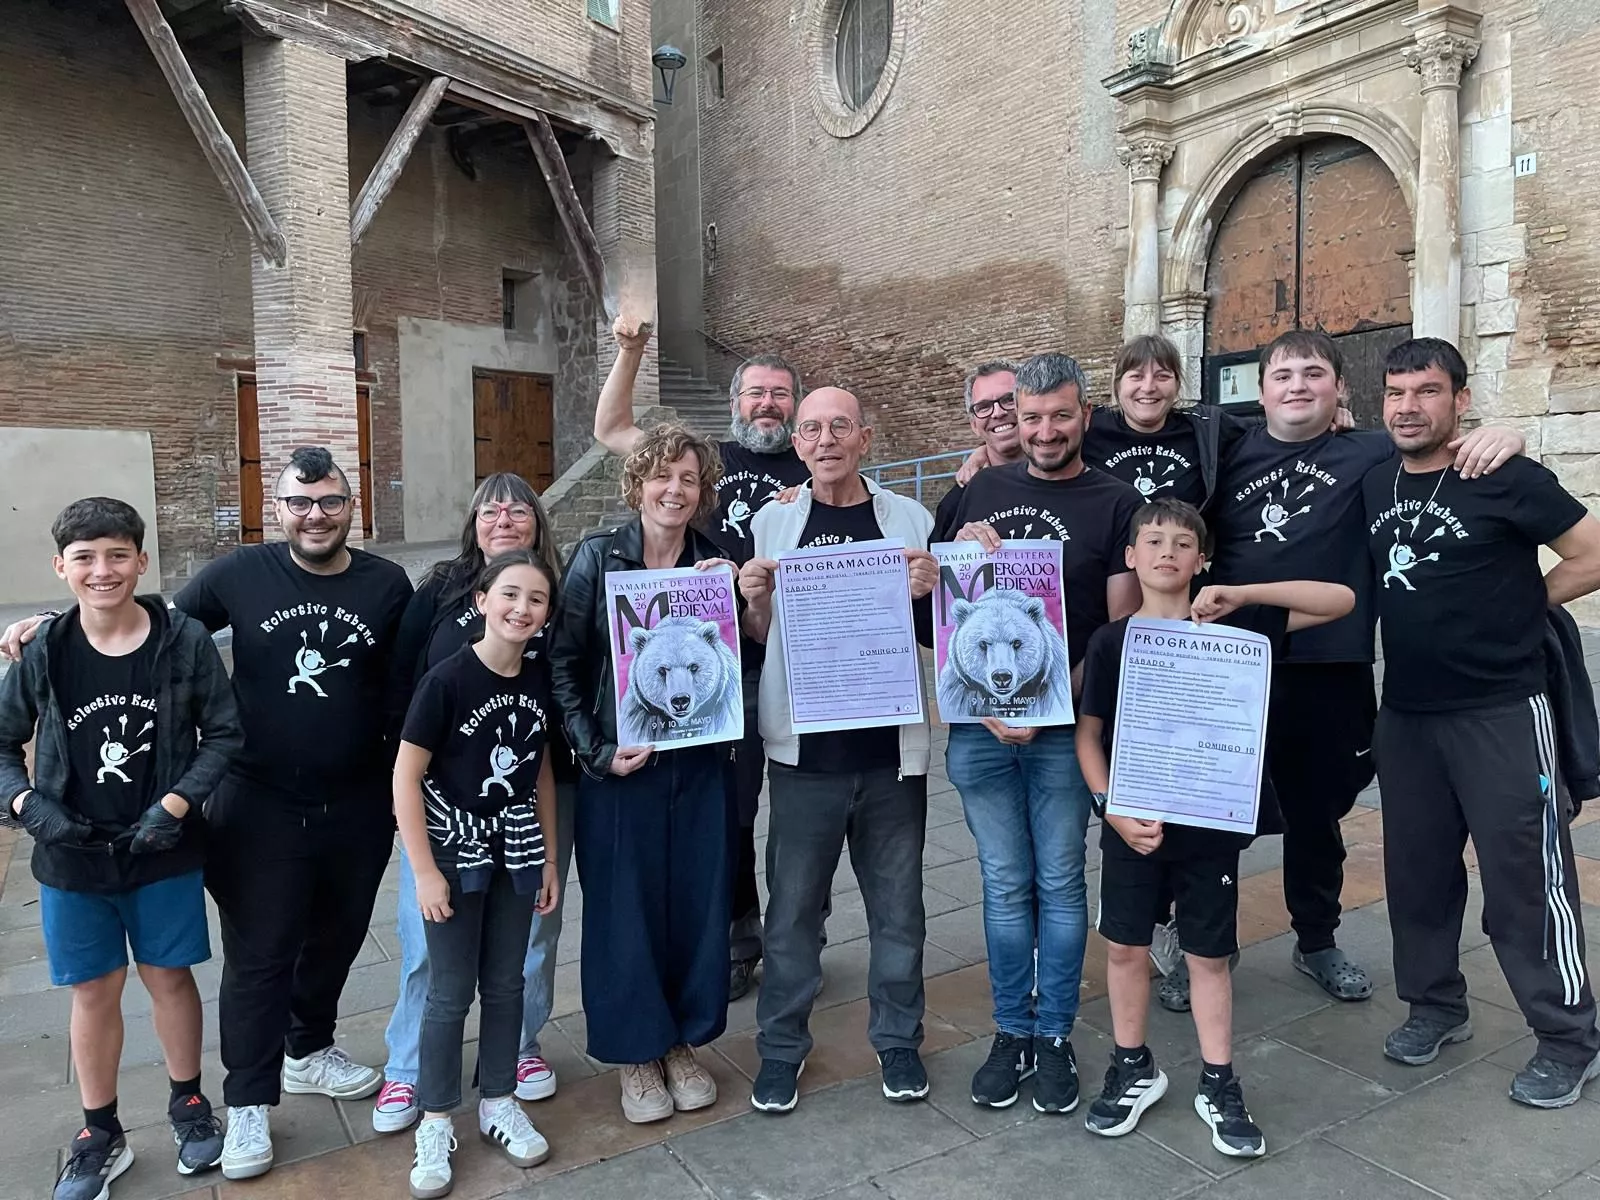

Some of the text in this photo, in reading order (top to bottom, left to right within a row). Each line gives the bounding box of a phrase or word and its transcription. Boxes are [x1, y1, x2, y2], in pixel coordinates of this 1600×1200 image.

[1520, 158, 1530, 172] 11
[1105, 445, 1191, 468] Kolectivo Kabana
[762, 473, 787, 491] Kaba
[1235, 460, 1337, 501] Kolecti Kabana
[1039, 509, 1071, 542] Kabana
[1370, 499, 1469, 539] Kolectivo Kabana
[938, 551, 1053, 562] TAMARITE DE LITERA
[785, 554, 901, 574] PROGRAMACIÓN
[959, 563, 971, 572] 20
[959, 572, 971, 581] 26
[613, 577, 725, 592] TAMARITE DE LITERA
[785, 584, 818, 593] SÁBADO
[633, 592, 646, 601] 20
[635, 602, 647, 610] 26
[260, 602, 376, 646] Kolectivo Kabana
[456, 607, 480, 627] Kol
[859, 647, 898, 657] DOMINGO
[1134, 633, 1262, 658] PROGRAMACIÓN
[1128, 657, 1165, 668] SÁBADO
[971, 697, 978, 705] 9
[988, 697, 998, 705] 10
[1013, 696, 1036, 705] MAYO
[67, 694, 126, 731] Kolectivo
[459, 694, 514, 736] Kolectivo
[651, 722, 658, 730] 9
[668, 720, 677, 728] 10
[690, 716, 712, 725] MAYO
[1198, 740, 1241, 752] DOMINGO
